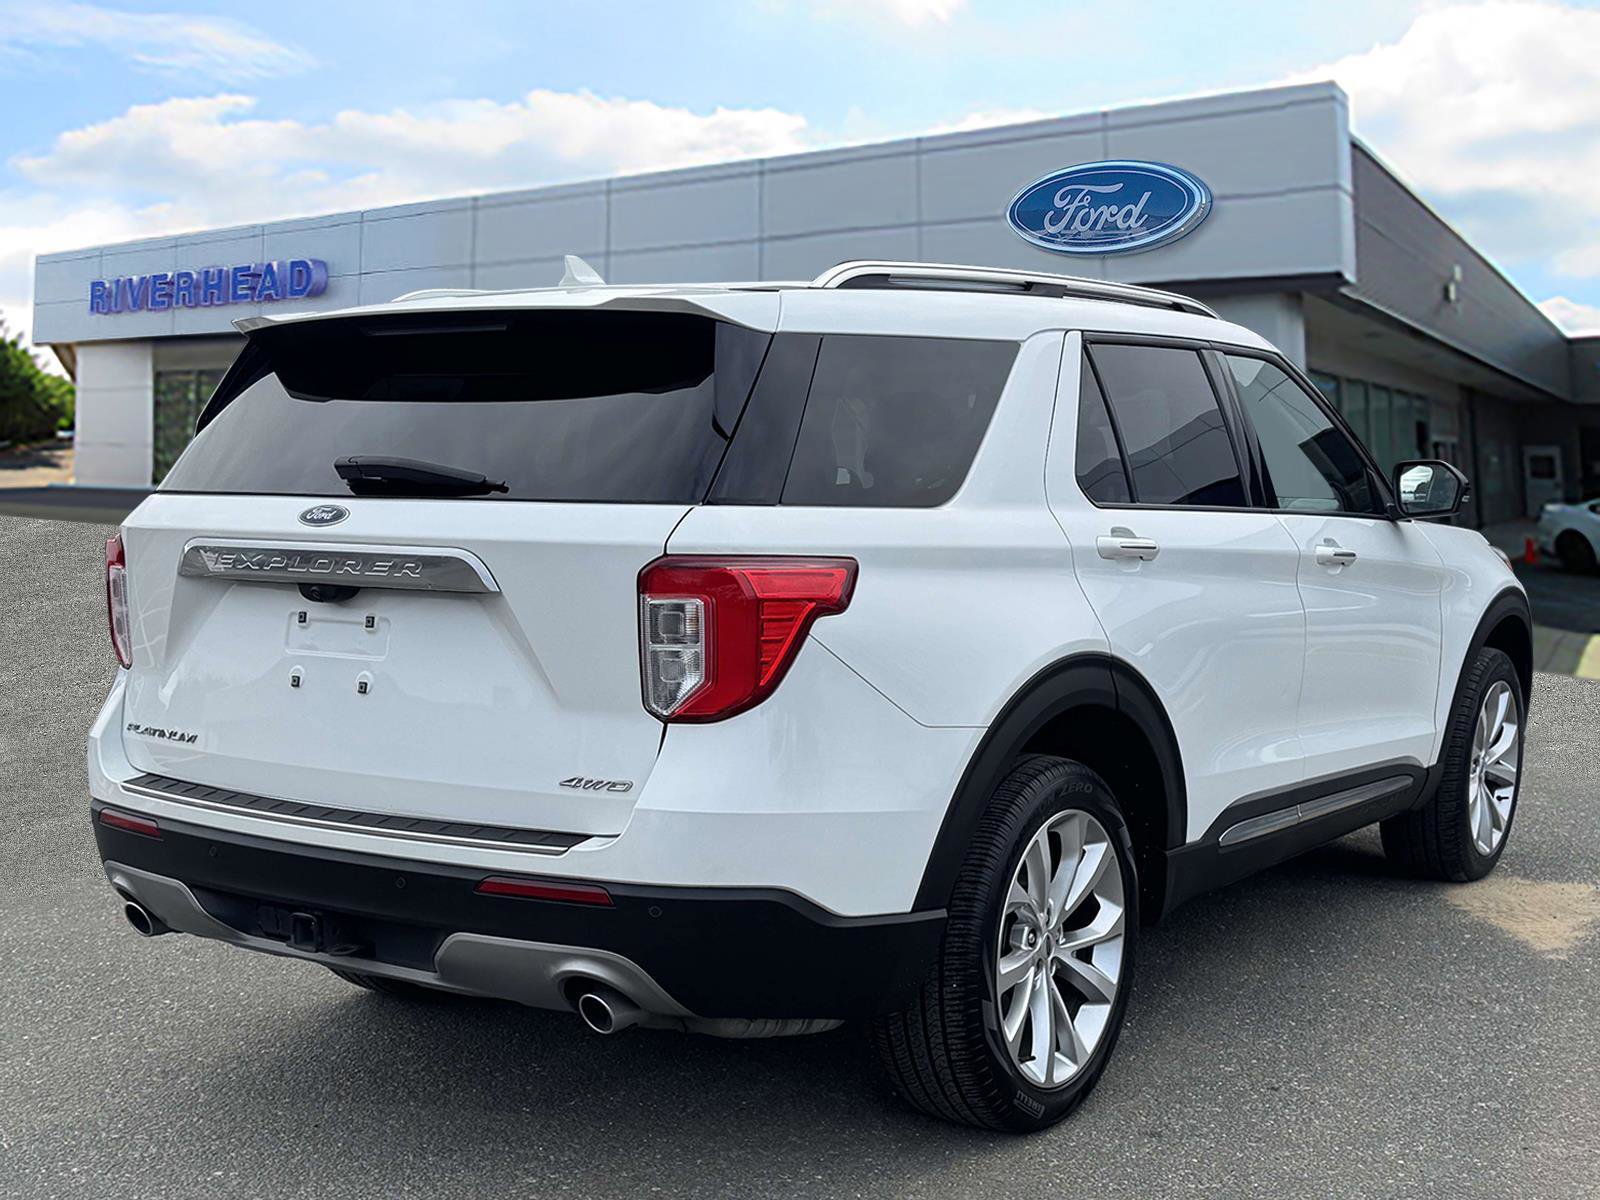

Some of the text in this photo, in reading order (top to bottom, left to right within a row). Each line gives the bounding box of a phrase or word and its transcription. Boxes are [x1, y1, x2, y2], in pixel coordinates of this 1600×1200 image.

[1044, 182, 1152, 234] Ford
[89, 259, 327, 315] RIVERHEAD
[305, 507, 338, 520] Ford
[214, 551, 424, 577] EXPLORER
[126, 723, 198, 744] PLATINUM
[559, 777, 633, 792] 4WD
[1058, 783, 1094, 797] ZERO
